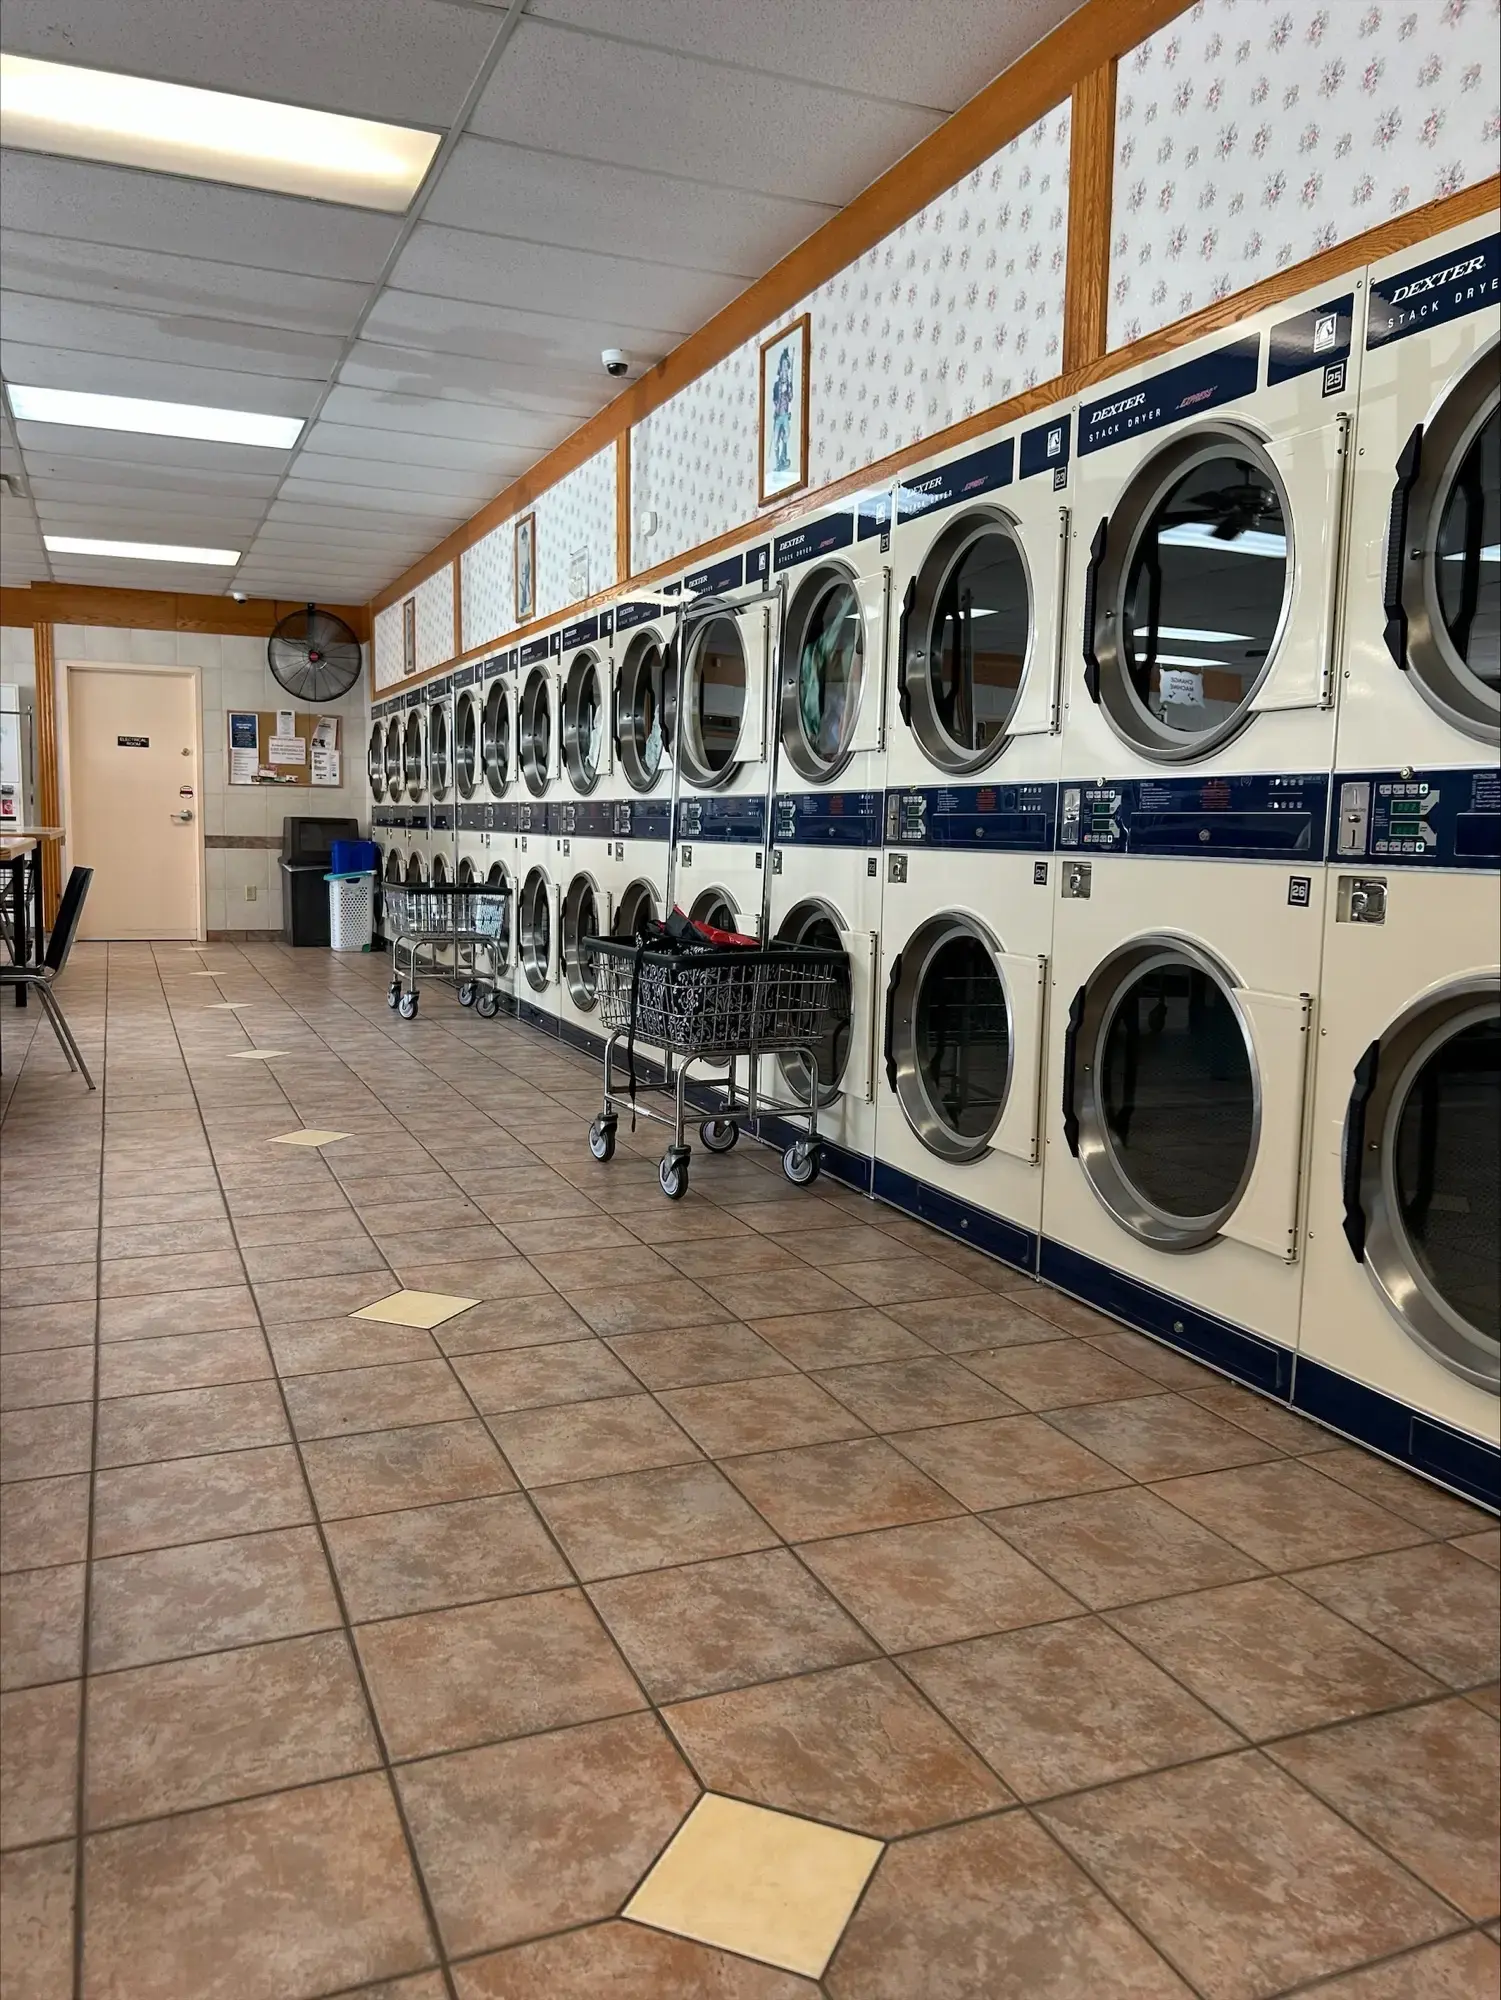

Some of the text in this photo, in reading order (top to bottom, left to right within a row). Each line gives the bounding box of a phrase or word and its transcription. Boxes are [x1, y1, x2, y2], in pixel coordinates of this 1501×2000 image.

[1389, 254, 1485, 305] DEXTER
[1387, 277, 1499, 329] STACK DRYE
[1327, 371, 1341, 386] 25
[1089, 392, 1146, 424] DEXTER
[1088, 408, 1161, 443] STACK DRYER
[906, 476, 943, 498] DEXTER
[1055, 472, 1065, 484] 23
[779, 534, 806, 552] DEXTER
[1035, 869, 1044, 879] 24
[1291, 885, 1306, 897] 26
